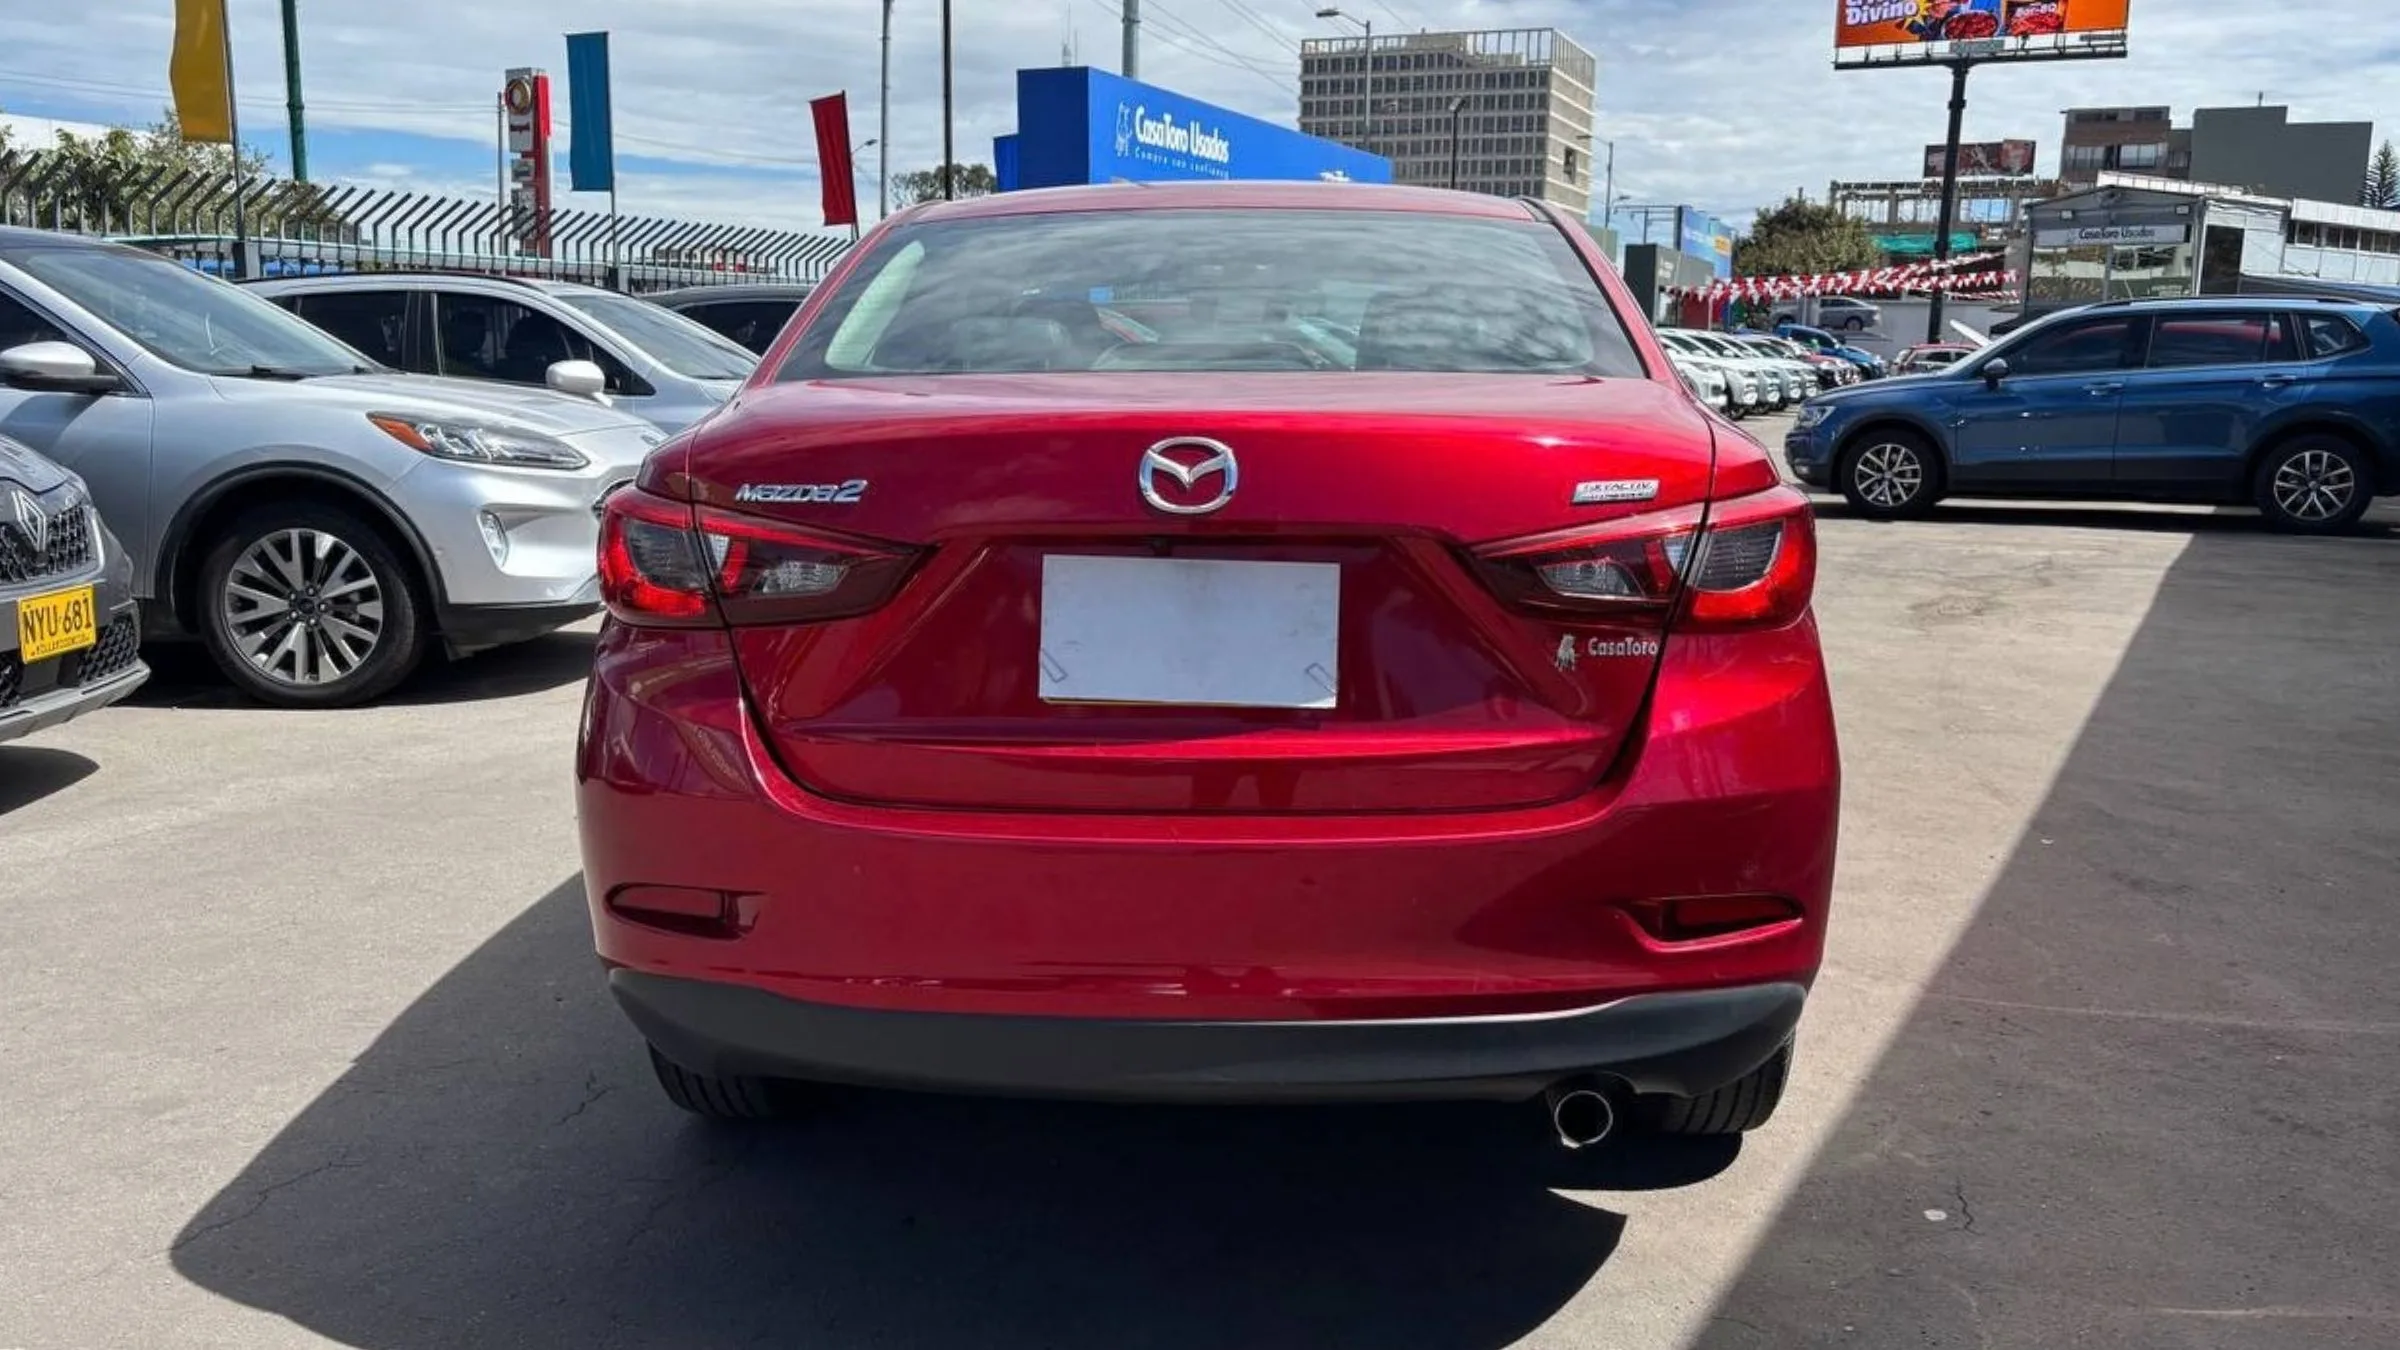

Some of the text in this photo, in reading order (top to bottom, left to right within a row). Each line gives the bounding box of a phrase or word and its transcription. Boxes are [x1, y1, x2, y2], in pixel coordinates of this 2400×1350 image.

[1846, 1, 1918, 26] Divino
[1190, 121, 1229, 163] Usados
[1587, 637, 1658, 656] CasaToro
